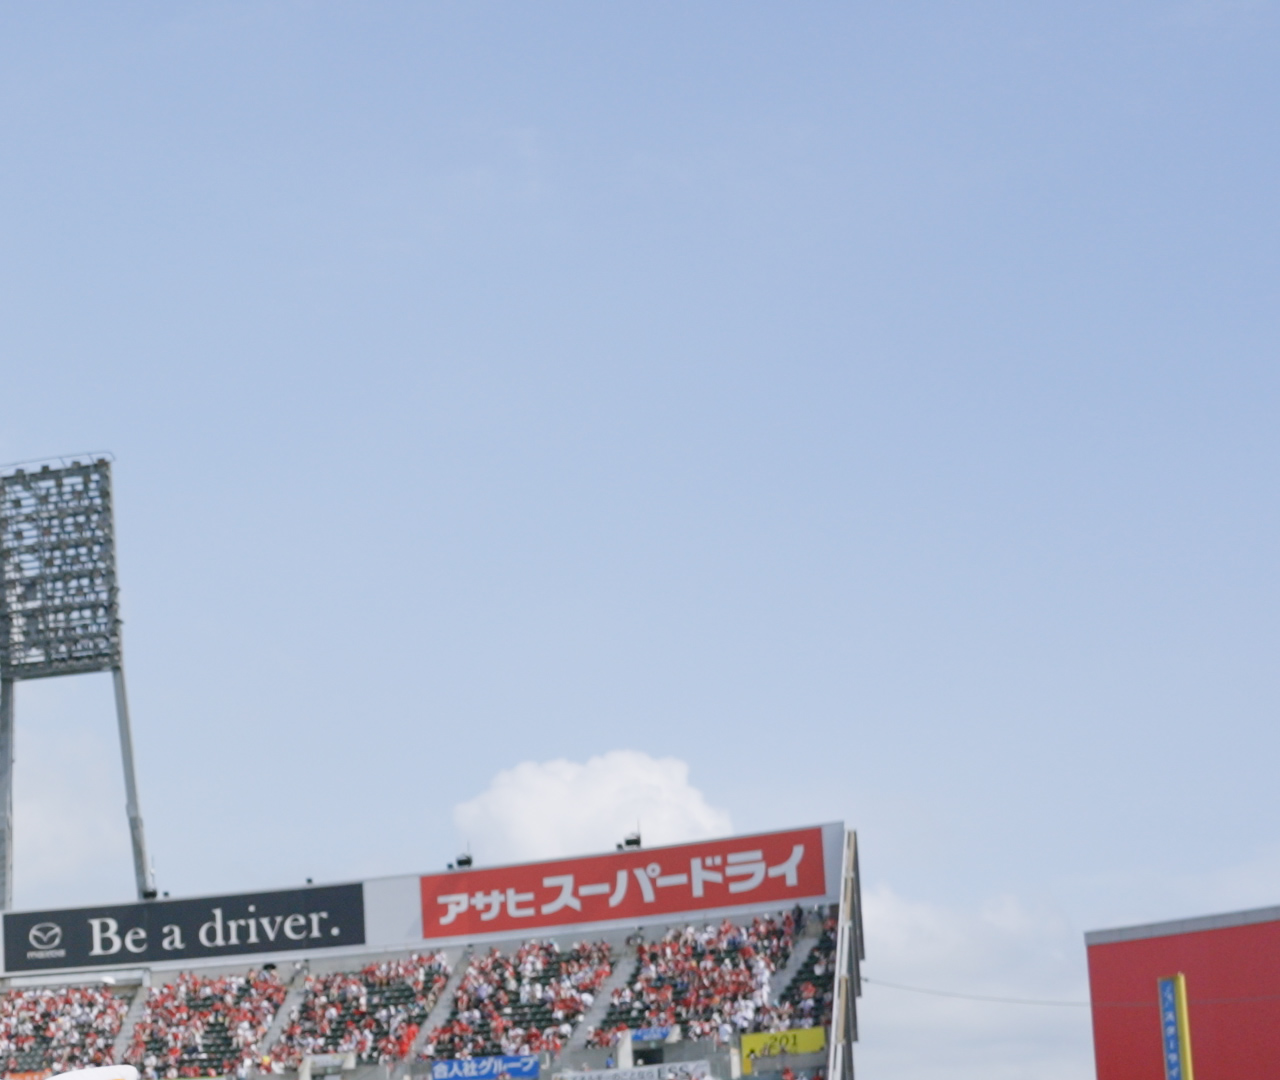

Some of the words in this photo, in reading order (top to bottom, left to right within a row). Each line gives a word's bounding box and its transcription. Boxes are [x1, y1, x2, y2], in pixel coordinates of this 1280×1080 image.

[88, 917, 147, 956] Be
[162, 924, 185, 951] a
[199, 904, 340, 947] driver.
[769, 1034, 798, 1048] 201
